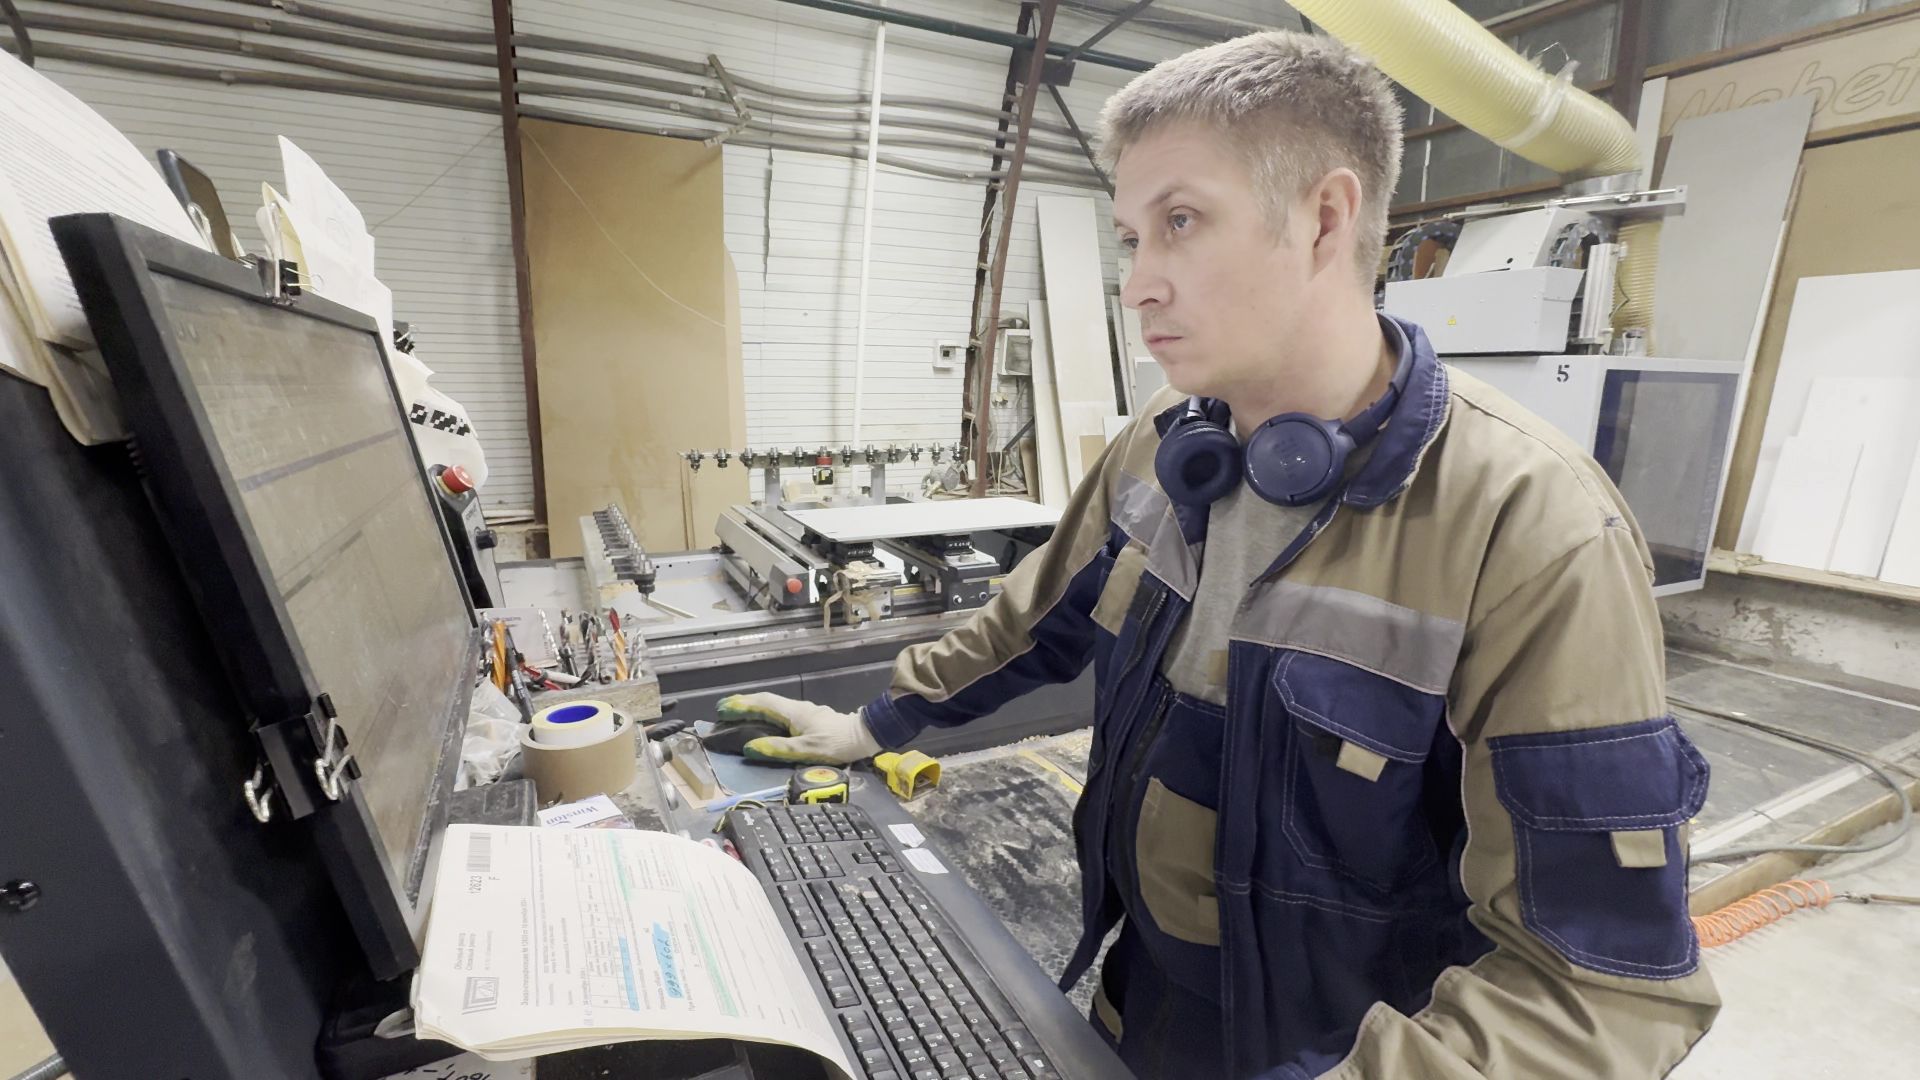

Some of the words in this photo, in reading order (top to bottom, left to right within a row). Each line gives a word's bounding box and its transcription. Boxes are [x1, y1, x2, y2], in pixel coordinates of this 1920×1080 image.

[1556, 364, 1569, 383] 5
[545, 806, 599, 825] Winston
[469, 875, 483, 894] 12623
